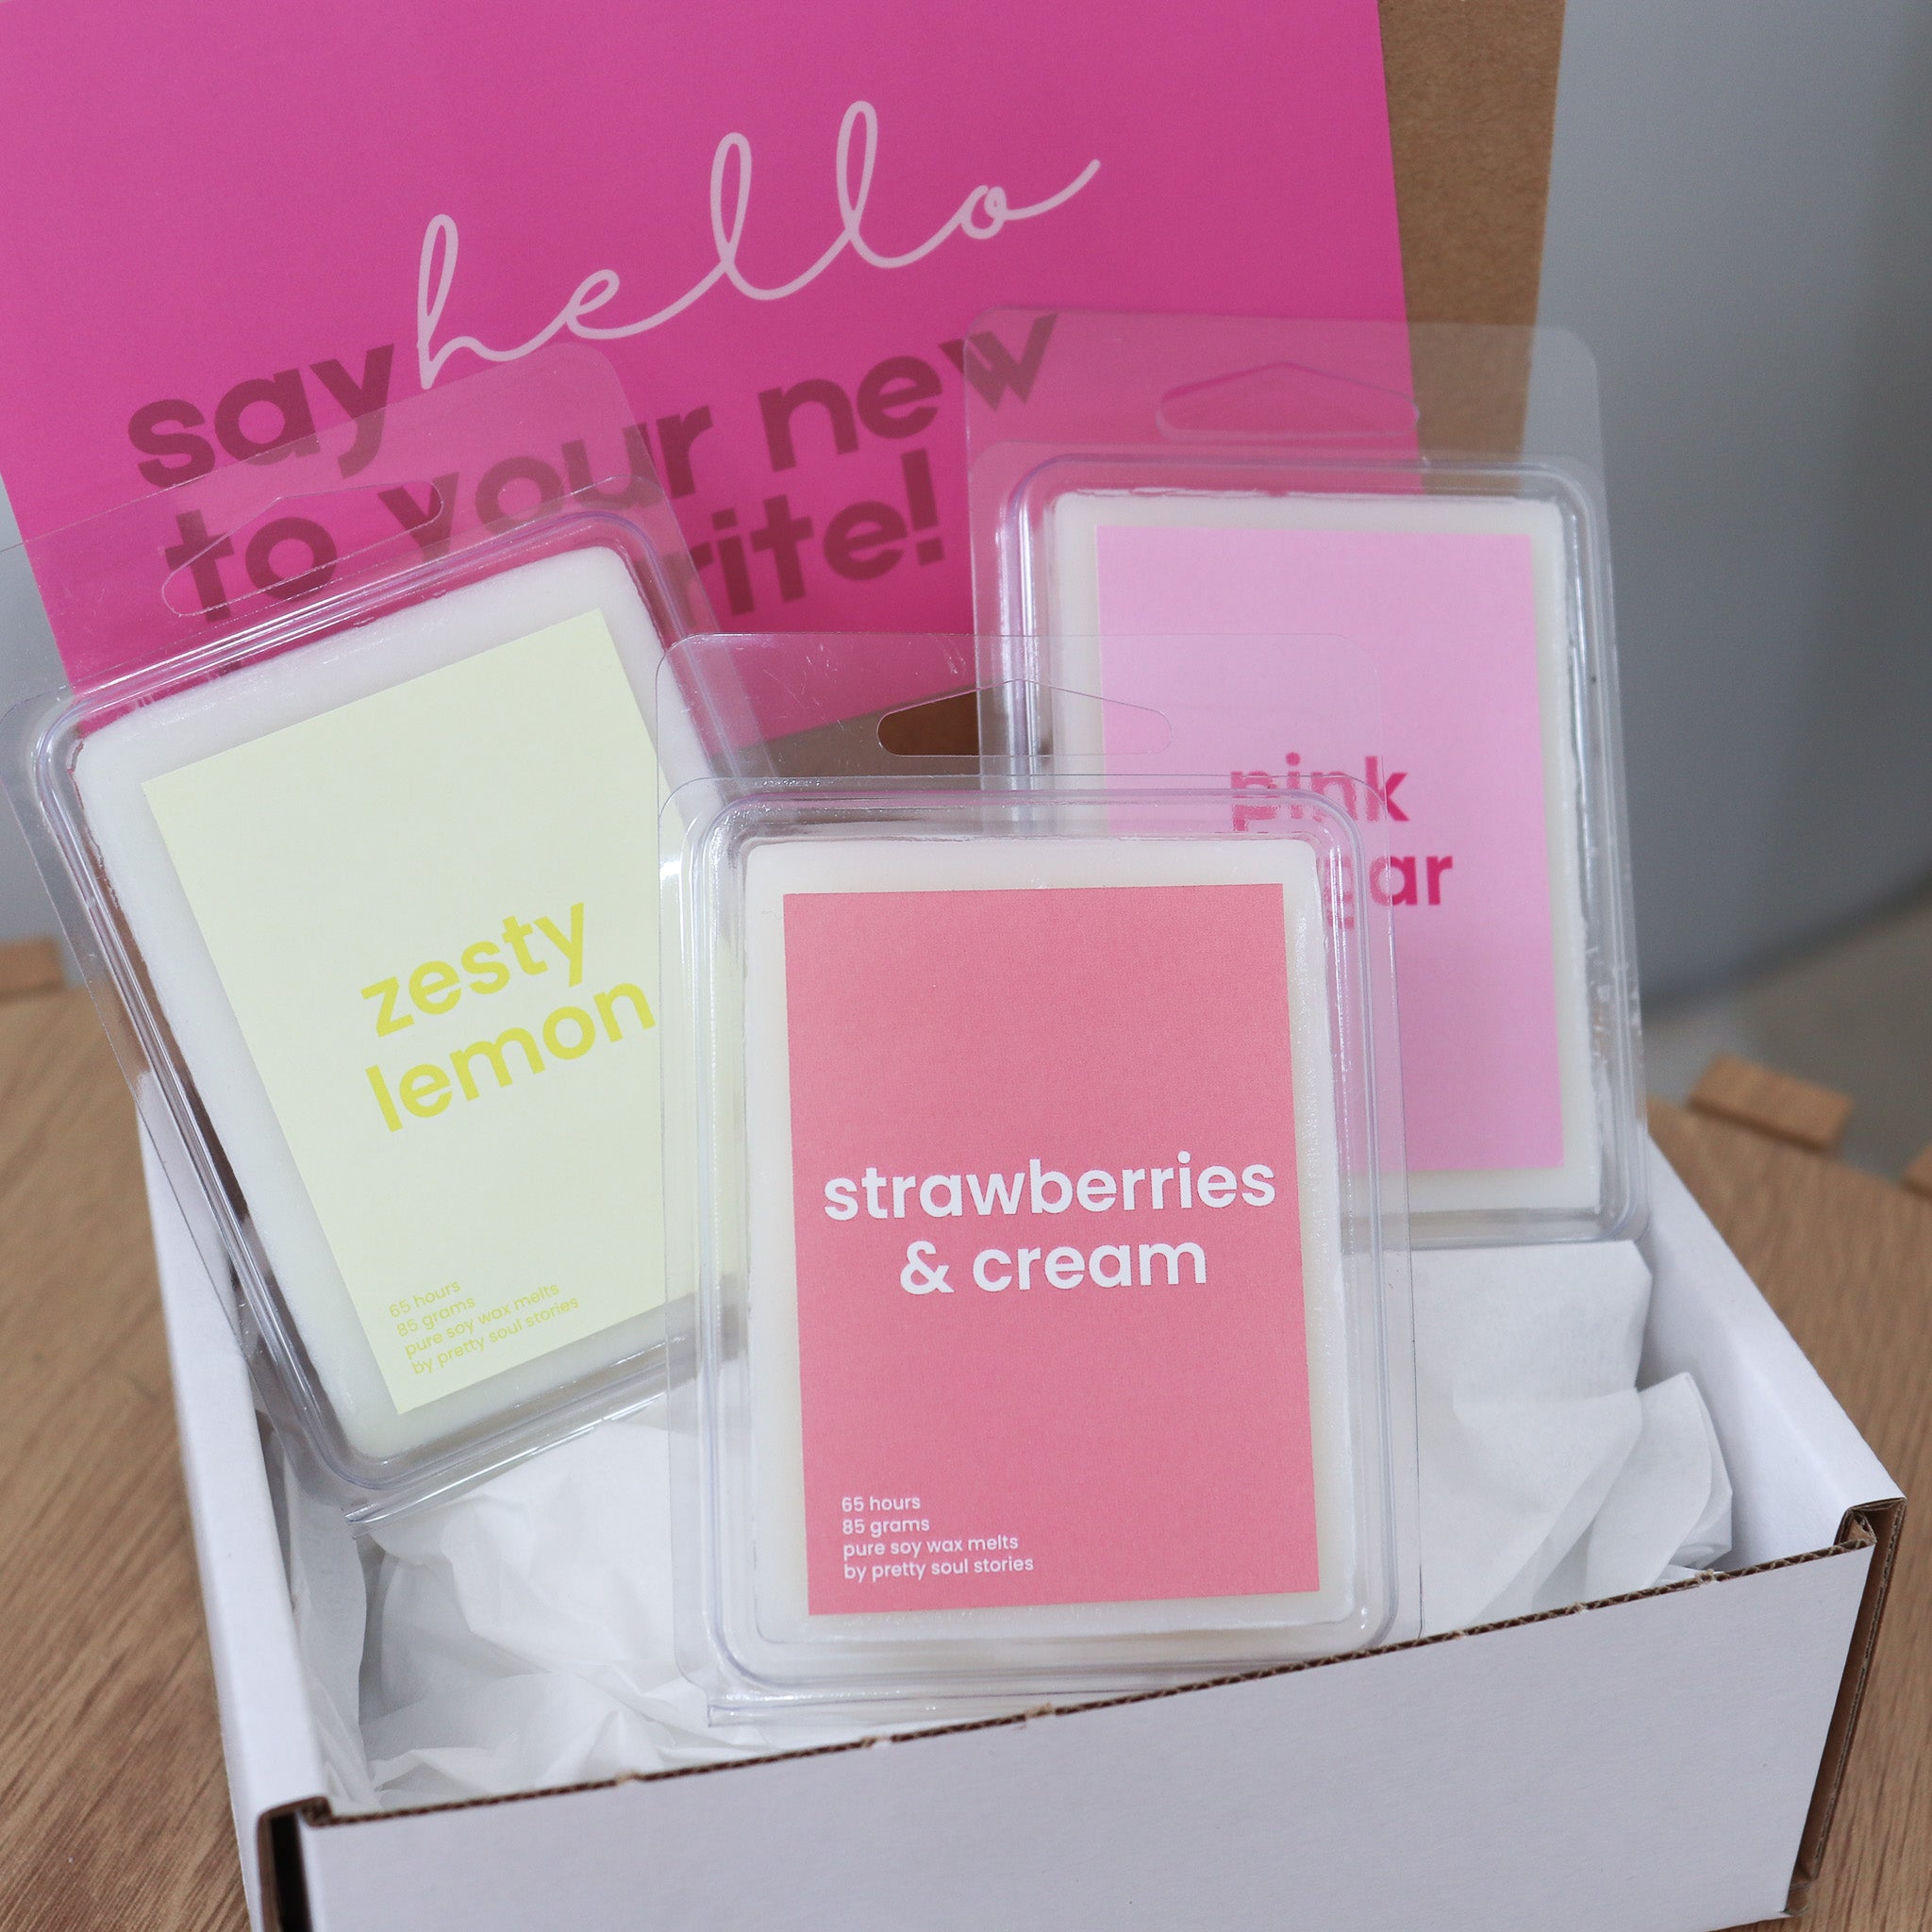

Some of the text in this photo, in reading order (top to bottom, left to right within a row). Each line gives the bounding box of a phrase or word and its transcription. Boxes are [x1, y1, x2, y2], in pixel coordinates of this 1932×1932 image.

[127, 100, 1101, 490] say hello
[164, 312, 1059, 624] to your new
[1230, 752, 1409, 832] pink
[360, 902, 584, 1038] zesty
[365, 983, 656, 1132] lemon
[824, 1151, 1276, 1221] strawberries
[389, 1281, 460, 1318] 65 hours
[900, 1241, 1208, 1295] & cream
[396, 1297, 475, 1337] 85 grams
[405, 1284, 559, 1358] pure soy wax melts
[411, 1297, 580, 1374] by pretty soul stories
[841, 1495, 921, 1512] 65 hours
[842, 1518, 930, 1538] 85 grams
[843, 1534, 1019, 1561] pure soy wax melts
[844, 1556, 1034, 1583] by pretty soul stories
